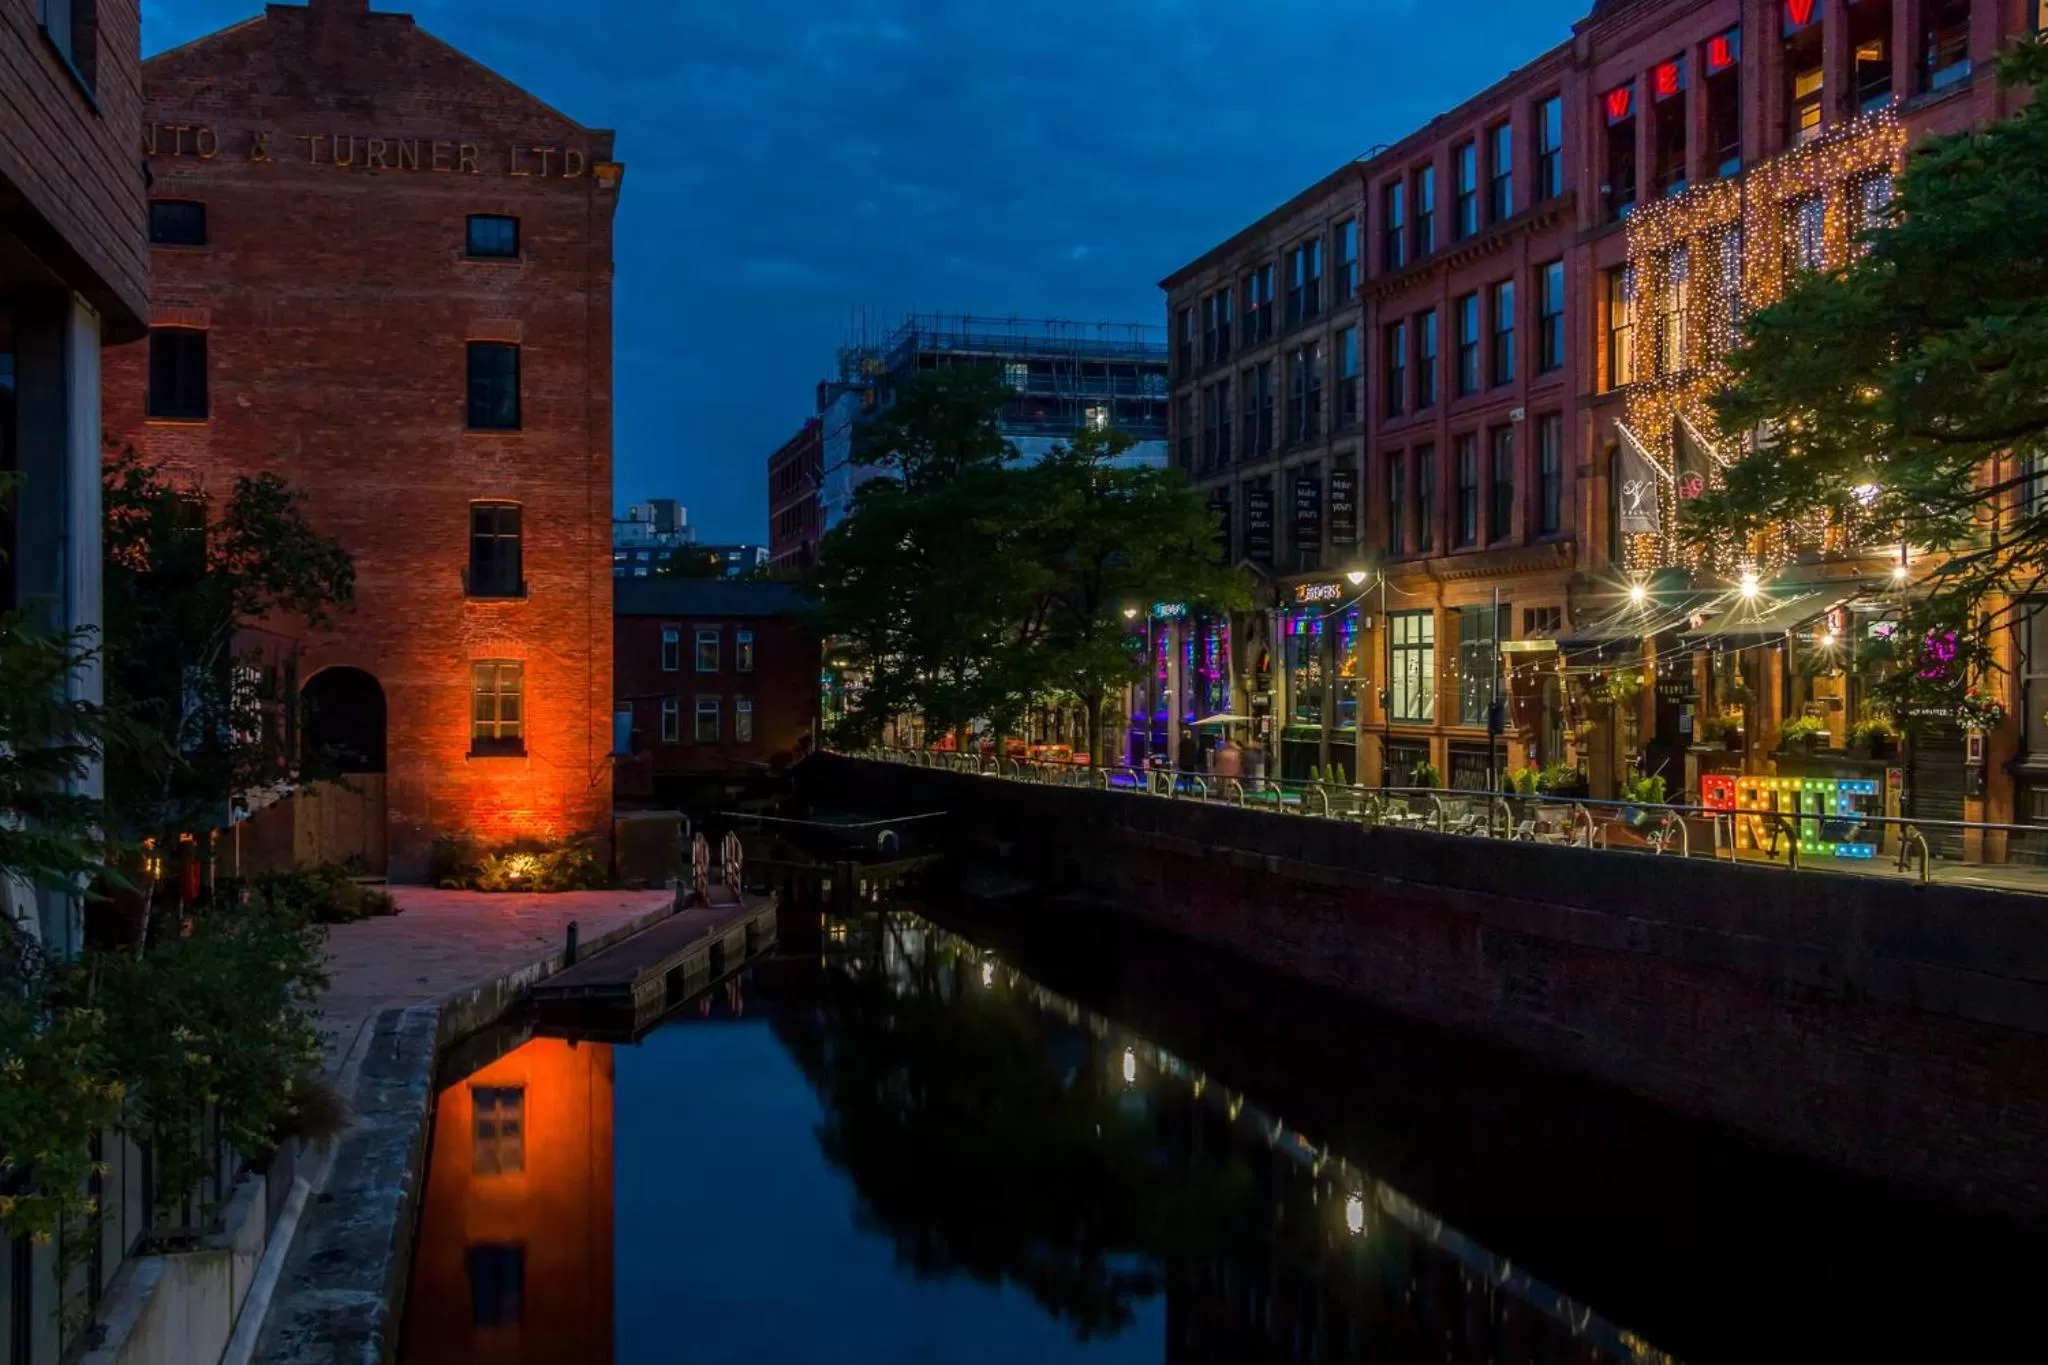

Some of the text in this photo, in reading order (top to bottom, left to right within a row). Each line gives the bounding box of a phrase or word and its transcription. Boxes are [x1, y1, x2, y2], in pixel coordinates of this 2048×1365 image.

[250, 131, 274, 163] &
[295, 133, 480, 174] TURNER
[510, 143, 584, 179] LTD
[1702, 775, 1879, 858] PRIDE
